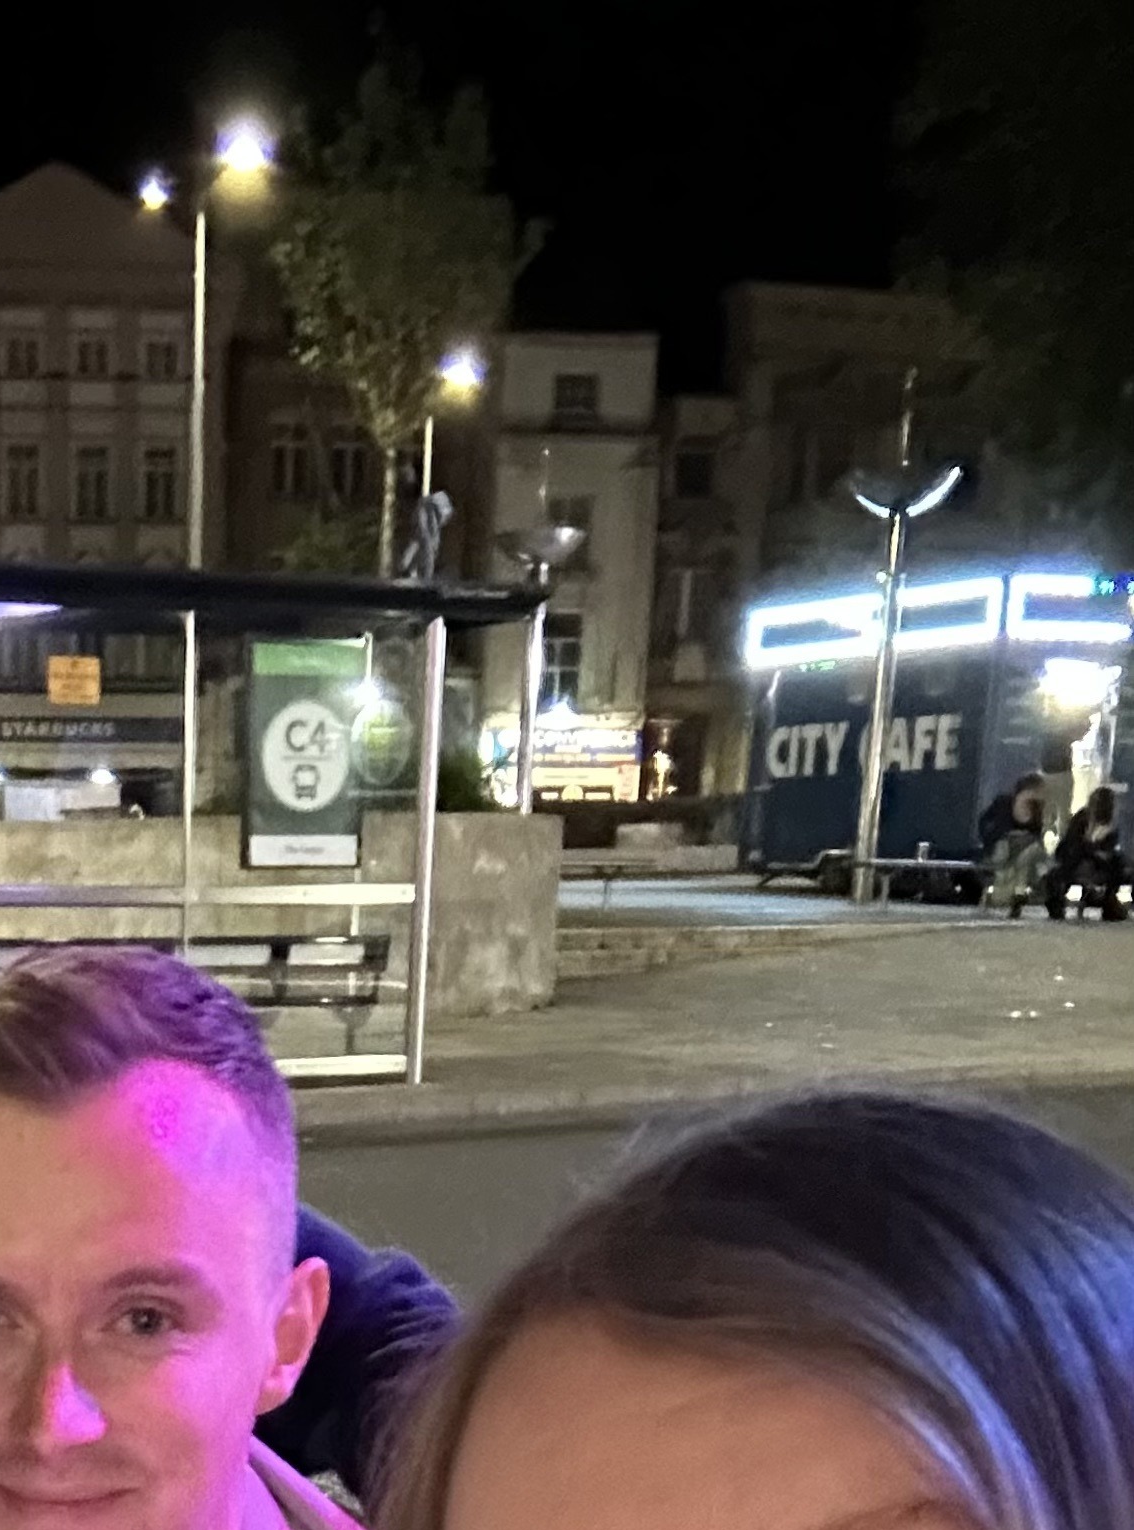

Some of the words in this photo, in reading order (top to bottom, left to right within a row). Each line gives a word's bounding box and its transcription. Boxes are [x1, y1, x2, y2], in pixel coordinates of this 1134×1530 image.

[2, 721, 115, 738] STARBUCKS
[286, 719, 331, 754] C4
[768, 722, 848, 778] CITY
